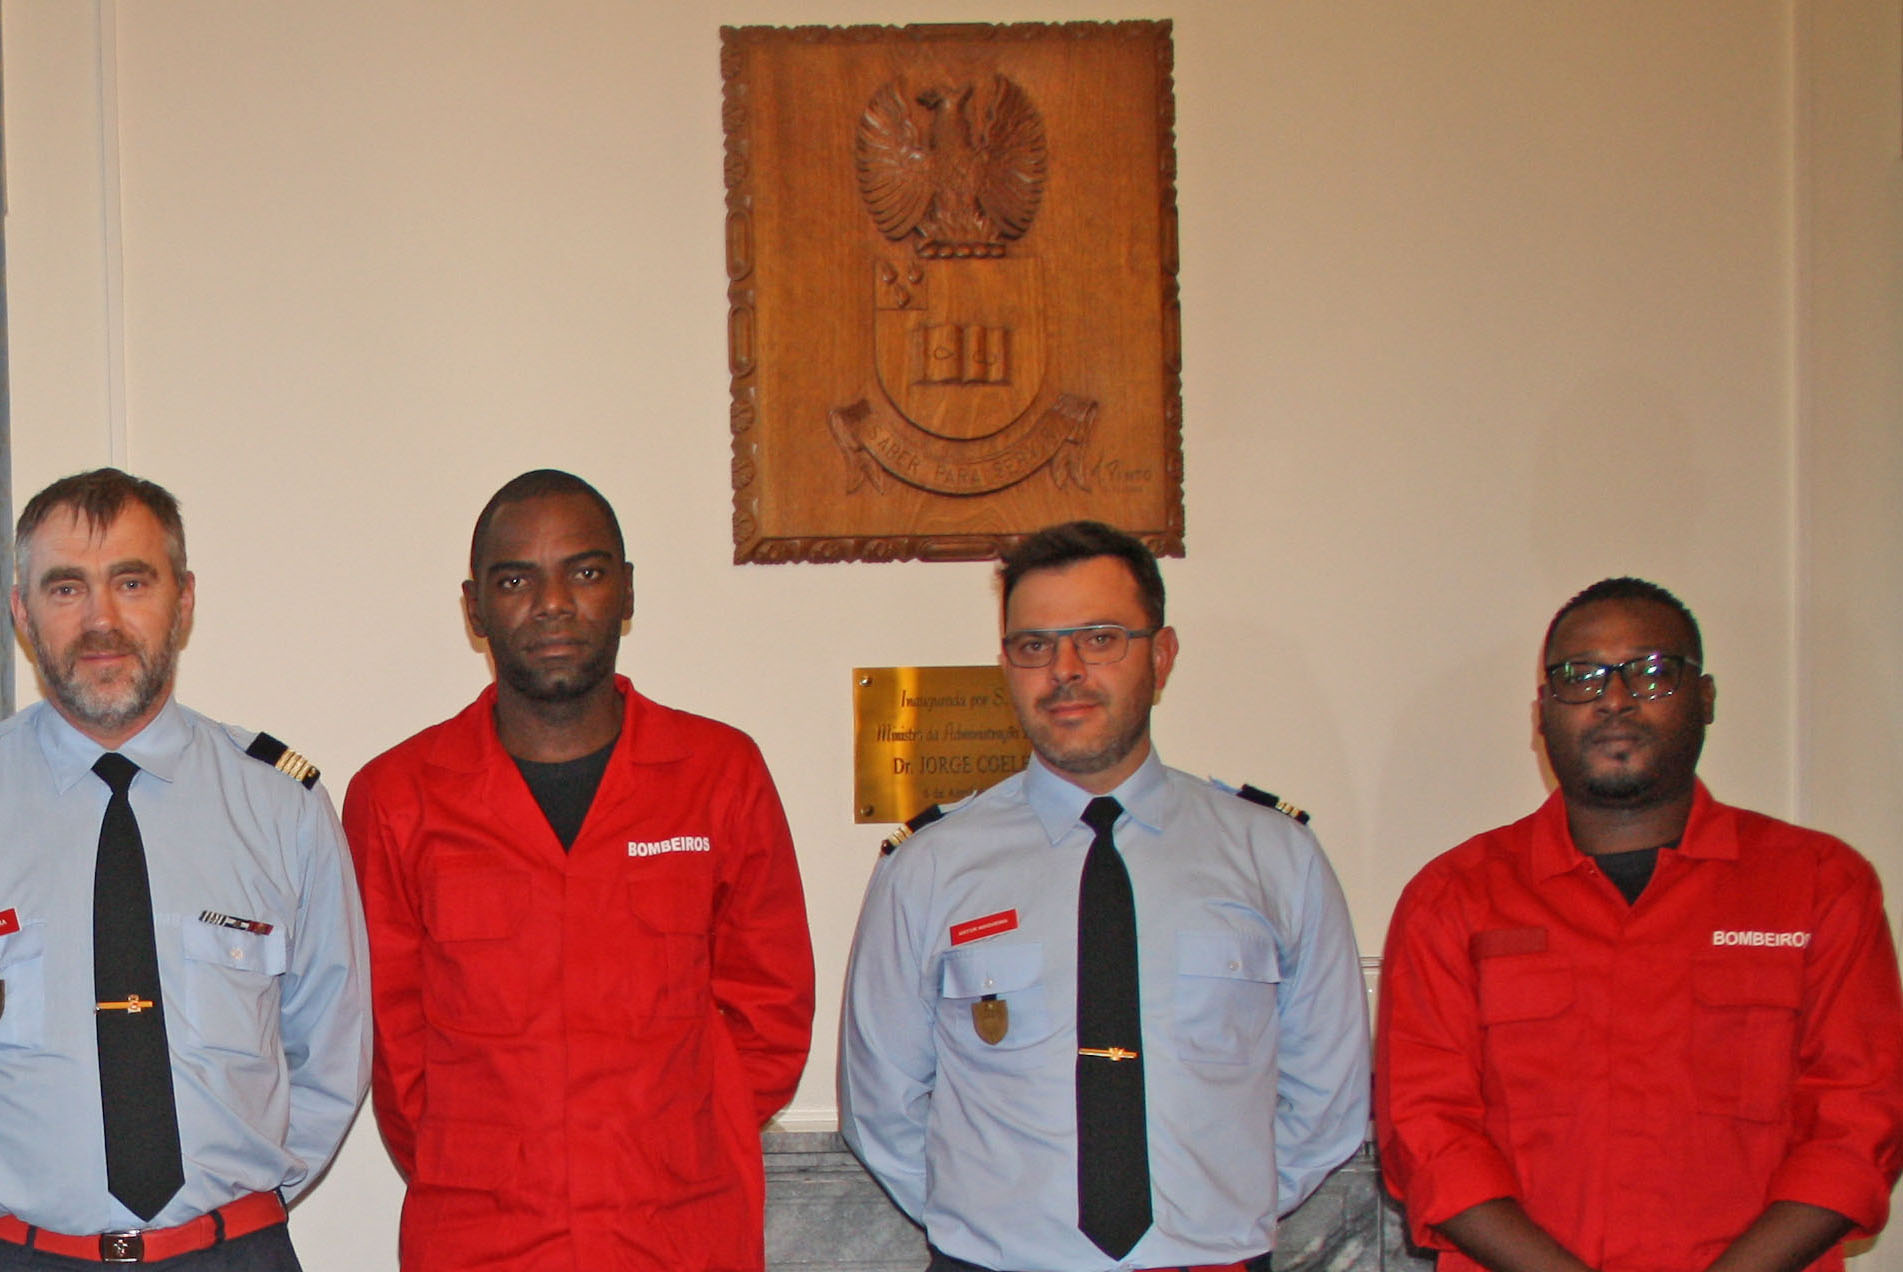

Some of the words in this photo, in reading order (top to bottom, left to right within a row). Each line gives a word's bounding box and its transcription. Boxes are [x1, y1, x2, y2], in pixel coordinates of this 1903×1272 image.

[934, 461, 981, 486] PARA
[893, 757, 912, 775] Dr.
[919, 756, 973, 775] JORGE
[627, 836, 710, 857] BOMBEIROS
